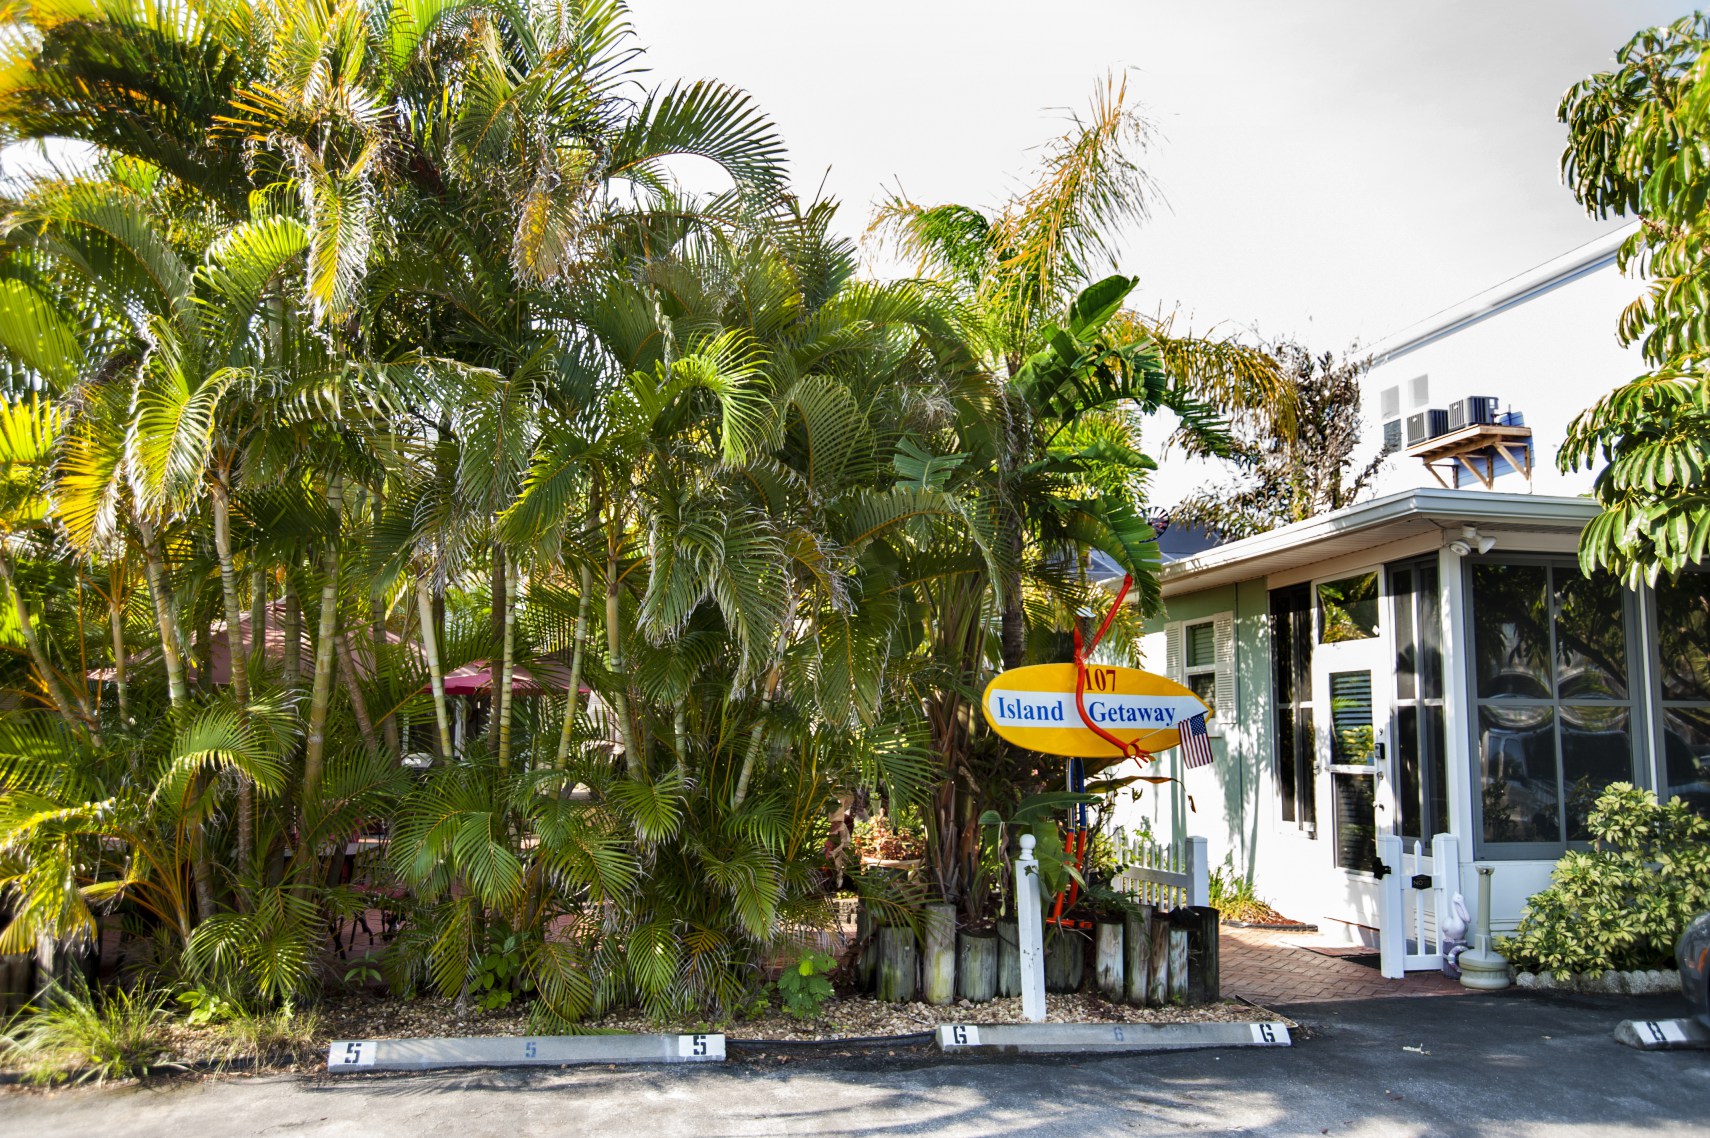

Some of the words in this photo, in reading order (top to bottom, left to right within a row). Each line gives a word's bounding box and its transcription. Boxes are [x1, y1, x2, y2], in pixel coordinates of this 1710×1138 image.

[1084, 668, 1116, 692] 107
[997, 697, 1065, 722] Island
[1088, 701, 1176, 726] Getaway
[1113, 1026, 1125, 1042] 6
[1645, 1021, 1668, 1042] 8
[344, 1042, 362, 1064] 5
[525, 1041, 537, 1058] 5
[693, 1035, 707, 1056] 5
